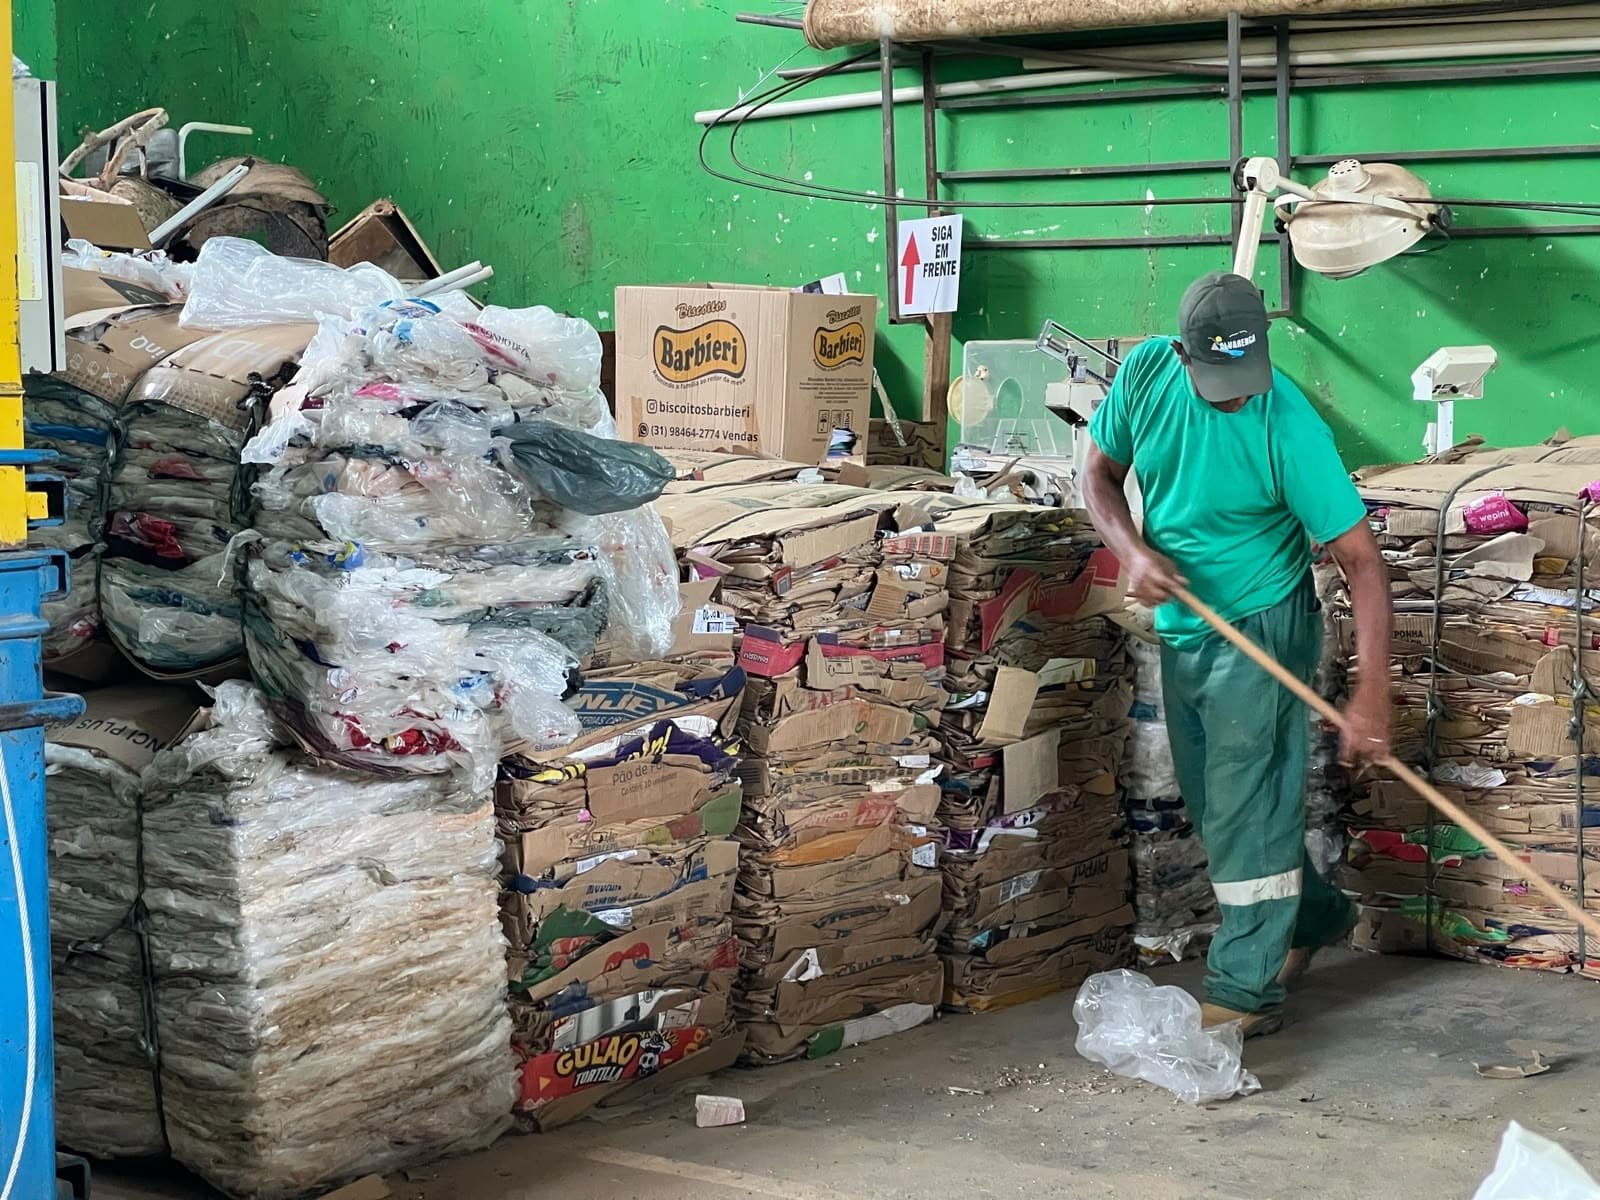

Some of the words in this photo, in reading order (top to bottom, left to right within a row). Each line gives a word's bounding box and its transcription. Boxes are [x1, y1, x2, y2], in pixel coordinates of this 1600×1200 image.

[931, 225, 952, 242] SIGA
[935, 243, 949, 259] EM
[923, 260, 957, 278] FRENTE
[675, 300, 727, 319] Biscoitos
[661, 333, 738, 372] Barbieri
[819, 331, 862, 360] Barbieri
[659, 401, 750, 418] biscoitosbarbieri
[650, 425, 668, 437] (31)
[669, 426, 720, 440] 98464-2774
[722, 430, 758, 442] Vendas
[1480, 509, 1509, 522] wepink
[77, 719, 126, 736] PLUS
[126, 729, 161, 752] NCI
[612, 769, 633, 786] Pão
[635, 765, 648, 777] de
[574, 1066, 624, 1087] TORTILLA
